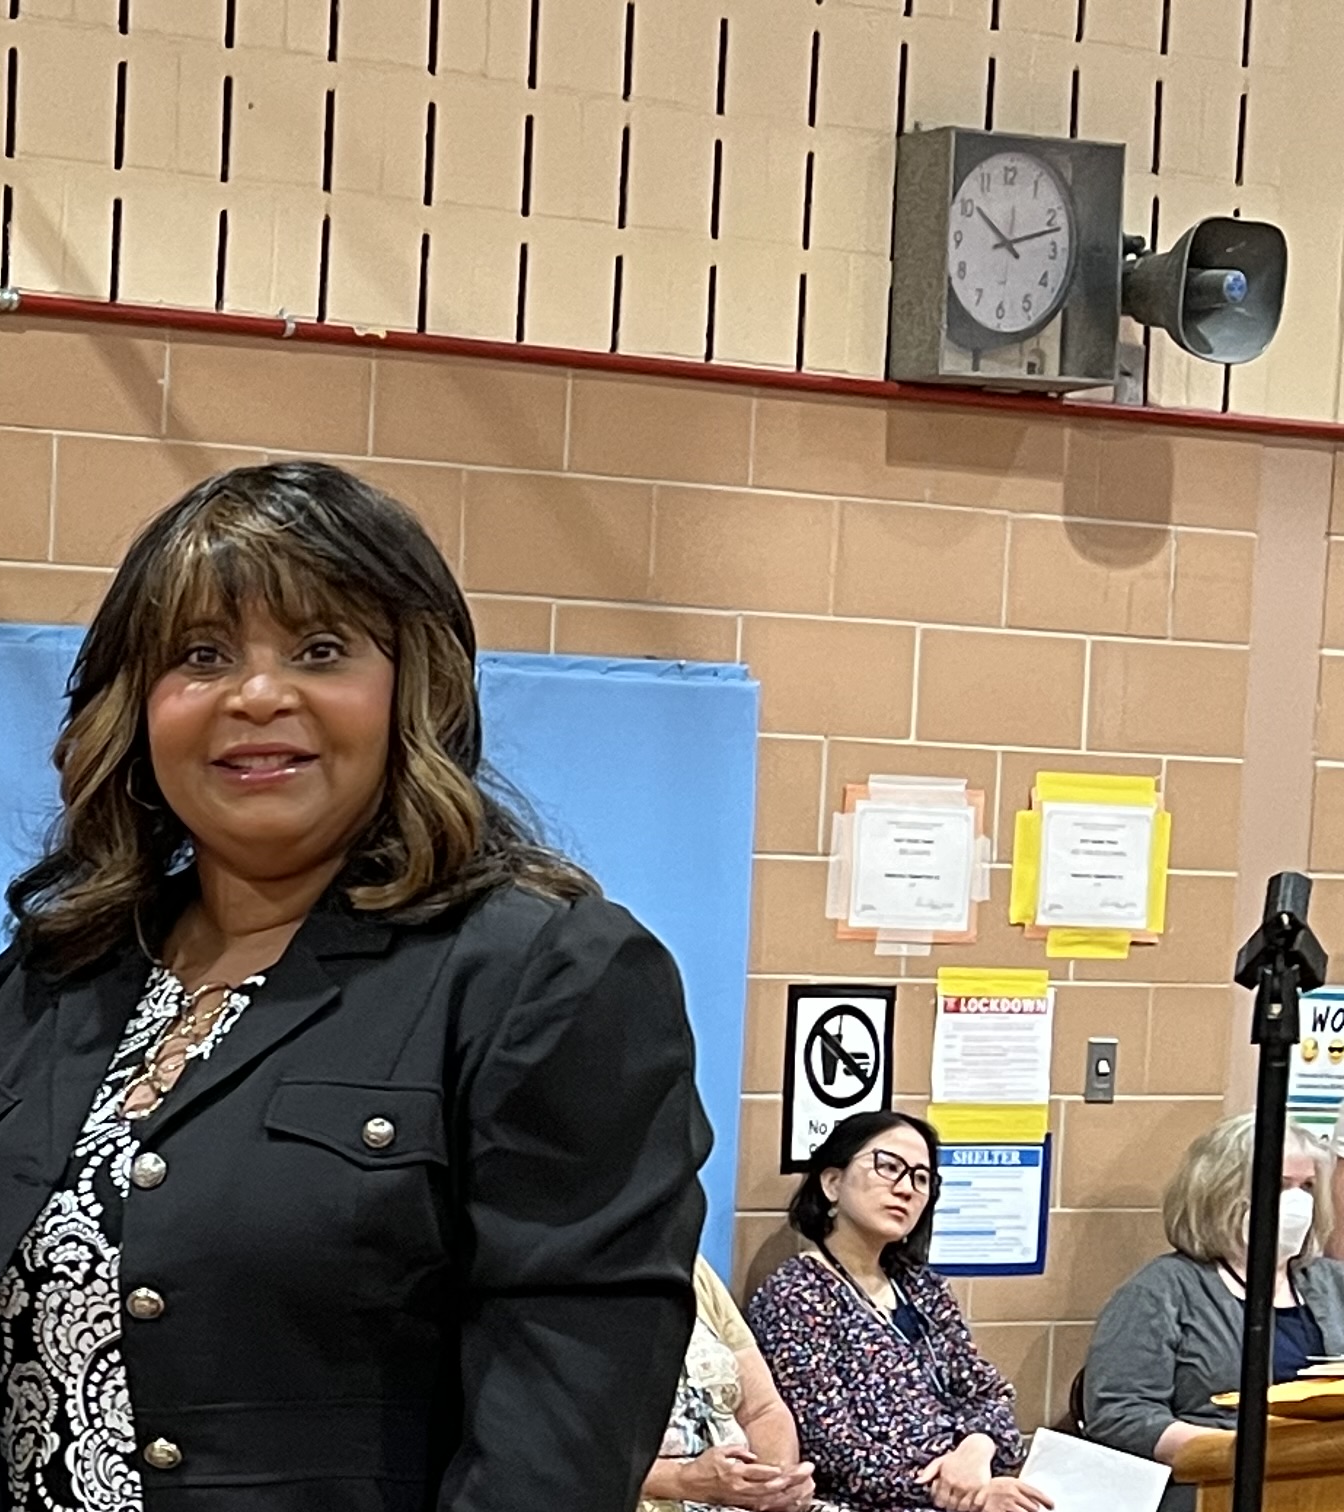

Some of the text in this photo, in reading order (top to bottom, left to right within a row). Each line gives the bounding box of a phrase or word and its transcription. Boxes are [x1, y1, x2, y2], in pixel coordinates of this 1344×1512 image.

[980, 172, 991, 193] 11
[1033, 179, 1040, 199] 1
[961, 198, 975, 218] 10
[1046, 208, 1057, 227] 2
[954, 230, 963, 249] 9
[1048, 241, 1058, 261] 3
[957, 261, 967, 281] 8
[1038, 270, 1049, 288] 4
[975, 288, 983, 307] 7
[1022, 293, 1032, 313] 5
[995, 301, 1005, 320] 6
[960, 997, 1047, 1013] LOCKDOWN
[808, 1119, 828, 1135] No
[952, 1150, 1022, 1165] SHELTER
